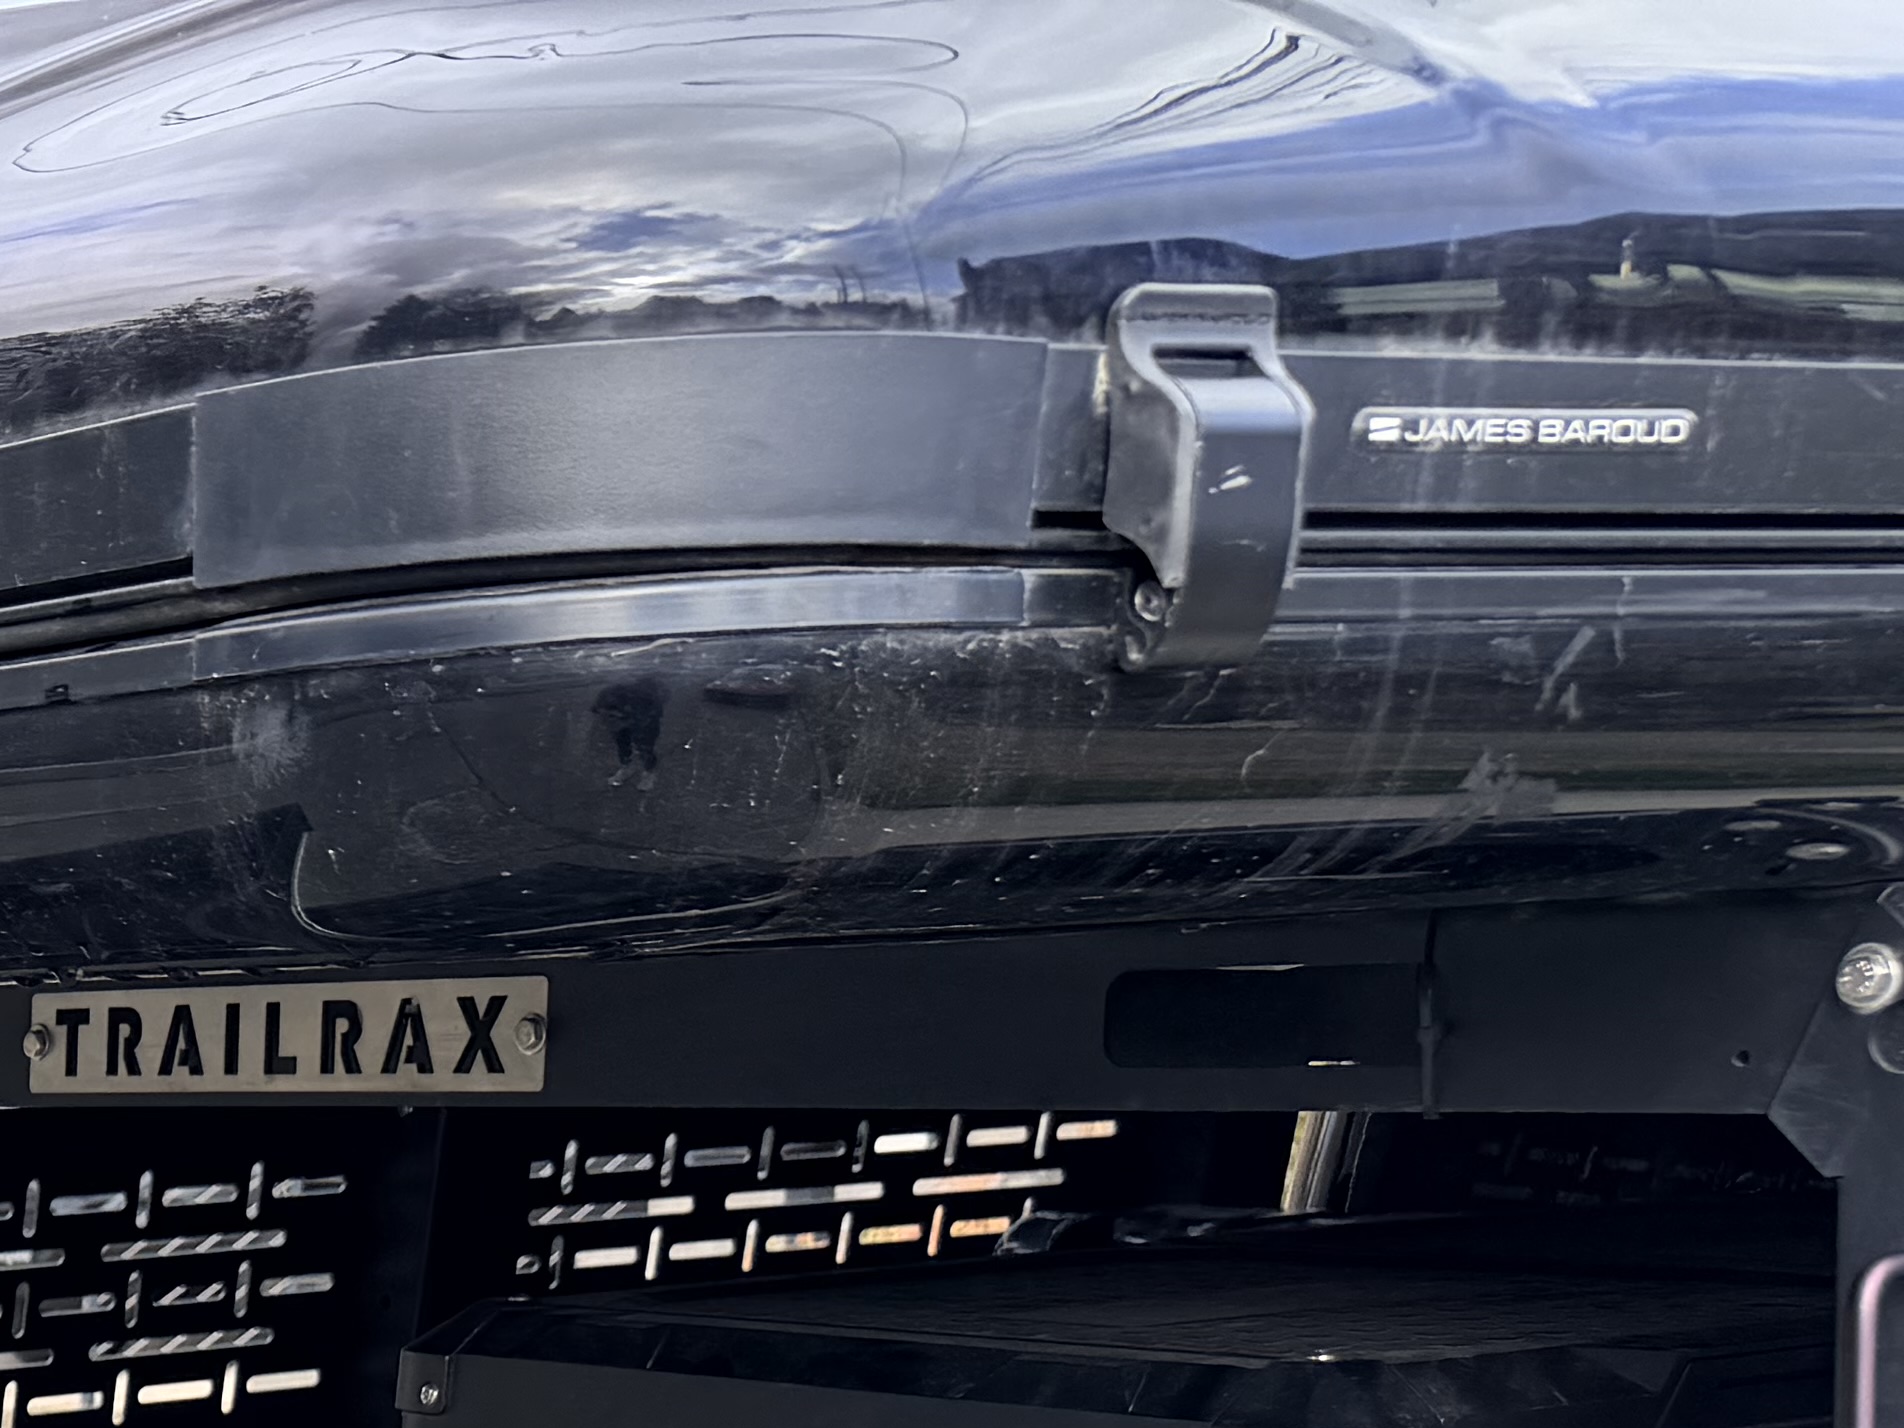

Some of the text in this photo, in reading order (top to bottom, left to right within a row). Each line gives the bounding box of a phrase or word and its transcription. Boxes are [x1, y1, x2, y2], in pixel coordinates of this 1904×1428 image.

[1404, 417, 1690, 443] JAMES BAROUD
[54, 994, 509, 1078] TRAILRAX
